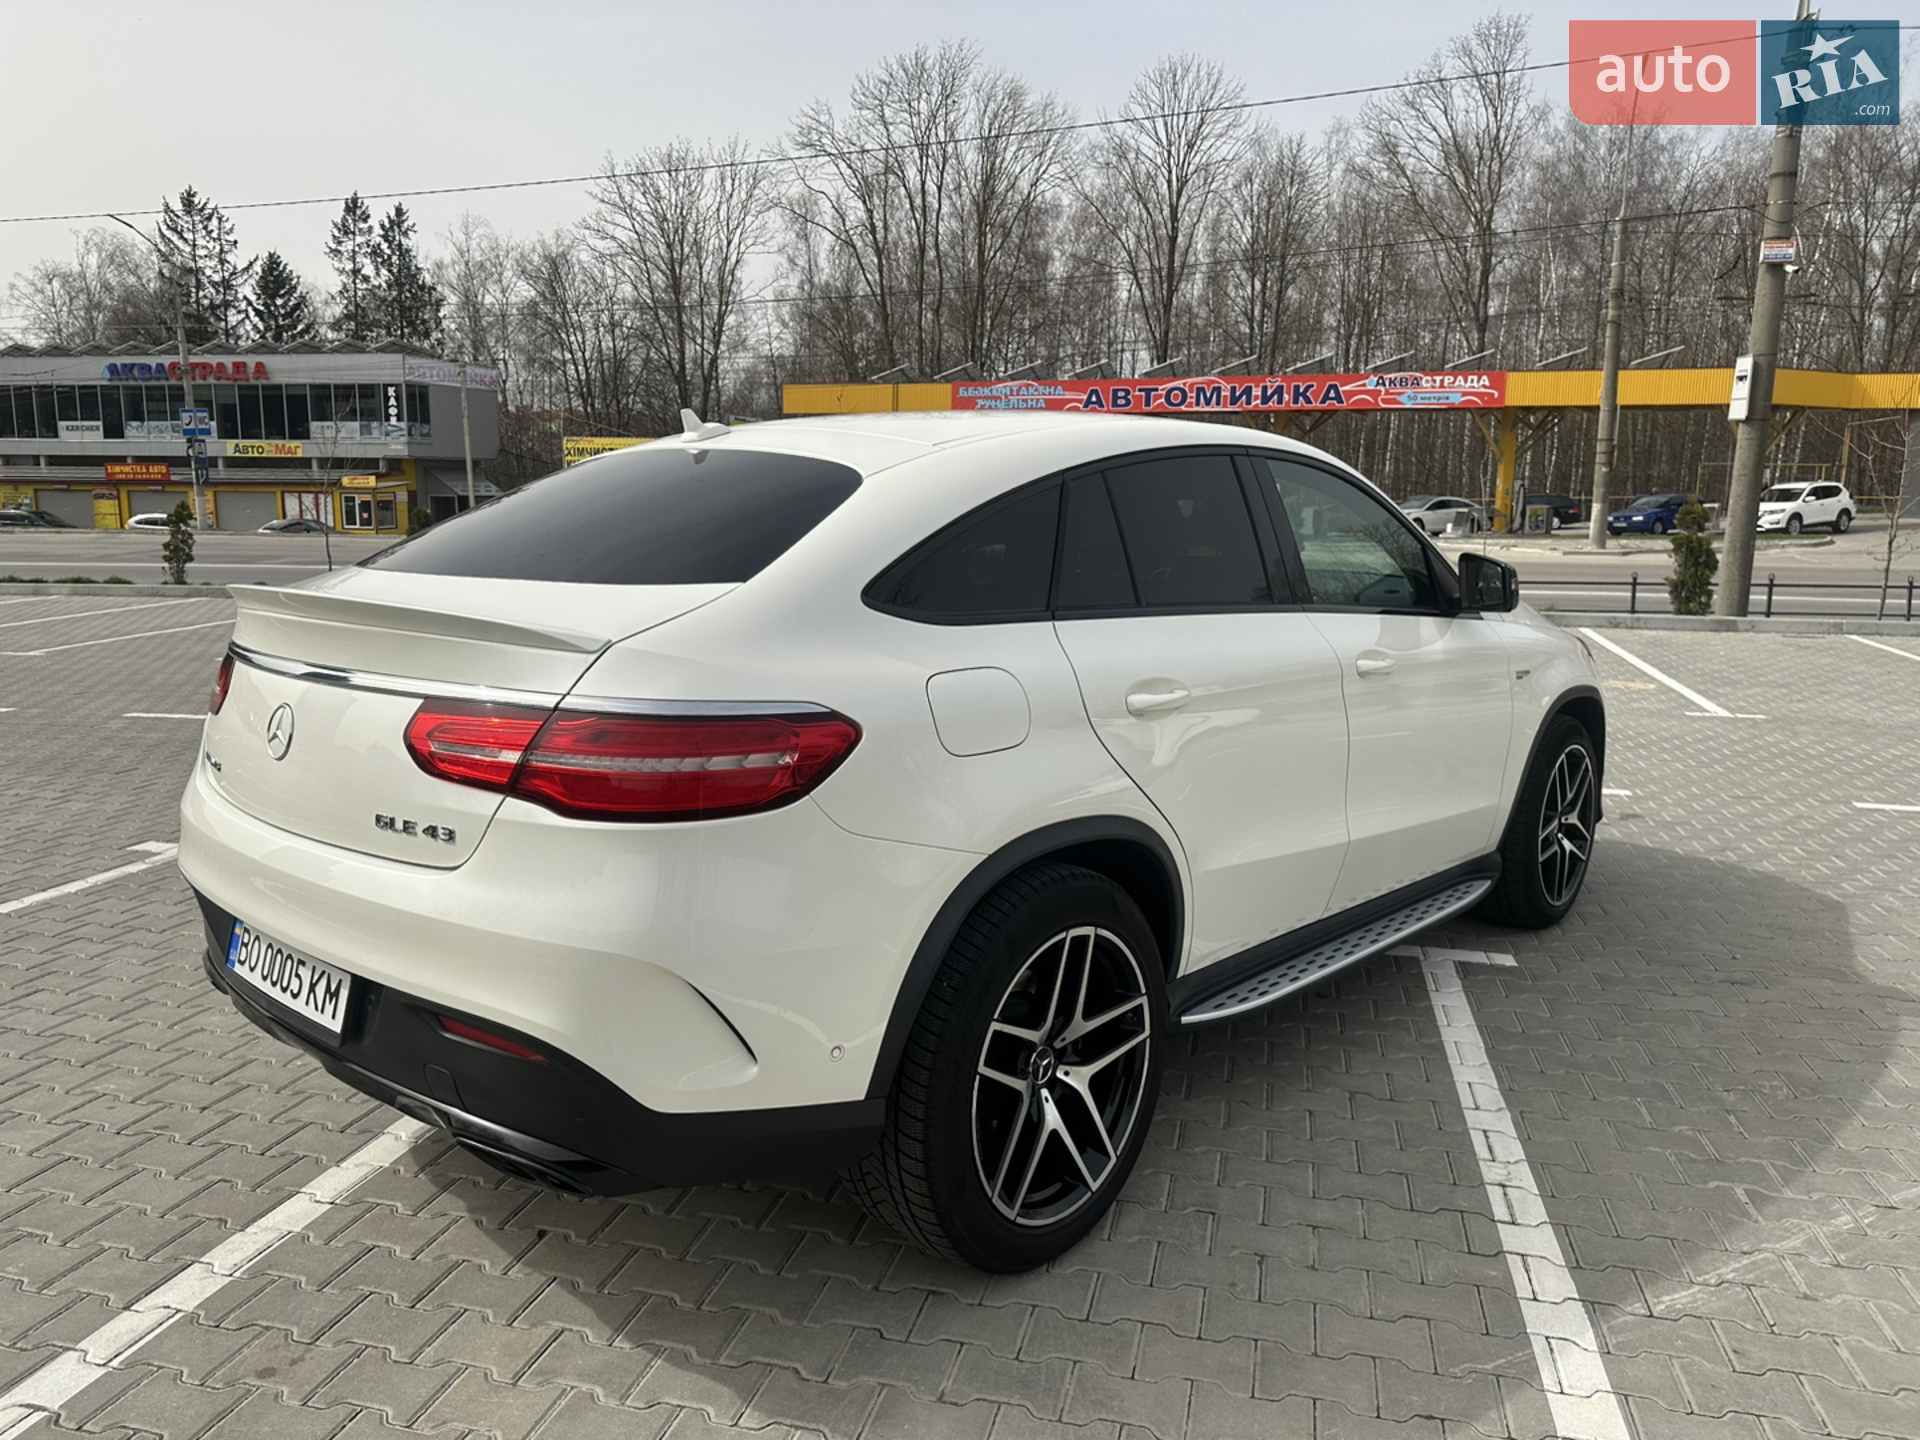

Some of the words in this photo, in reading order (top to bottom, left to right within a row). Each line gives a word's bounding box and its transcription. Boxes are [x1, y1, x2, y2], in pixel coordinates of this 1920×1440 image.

[107, 361, 269, 382] АКВАСТРАДА
[1375, 375, 1491, 389] АКВАСТРАДА
[958, 385, 1065, 397] БЕЗКОНТАКТНА
[1081, 378, 1346, 410] АВТОМИЙКА
[975, 398, 1046, 409] ТУНЕЛЬНА
[375, 813, 418, 838] GLE
[422, 824, 456, 845] 43
[238, 926, 261, 973] BO
[261, 942, 306, 1000] 0005
[305, 965, 342, 1021] KM
